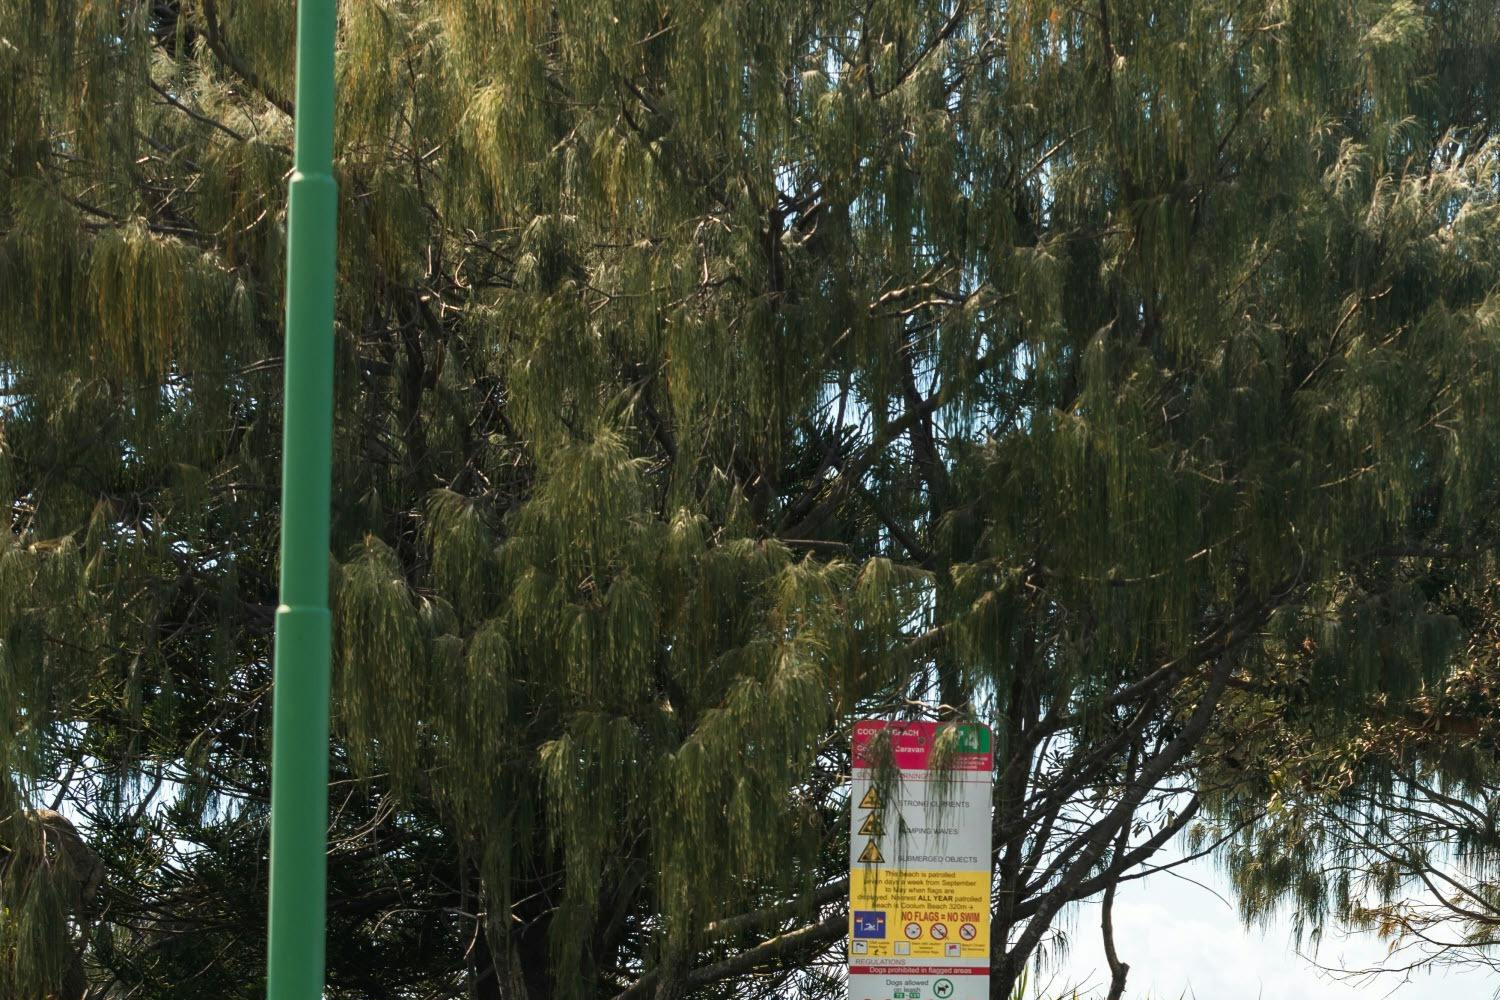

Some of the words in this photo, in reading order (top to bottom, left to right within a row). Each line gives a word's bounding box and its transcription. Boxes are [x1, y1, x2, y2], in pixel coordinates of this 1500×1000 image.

[857, 728, 890, 736] COOL
[897, 855, 943, 863] SUBMERGED
[944, 856, 978, 864] OBJECTS
[928, 871, 956, 880] patrolled
[942, 879, 976, 888] September
[927, 887, 943, 896] flags
[902, 911, 913, 921] NO
[914, 911, 939, 922] FLAGS
[947, 912, 958, 922] NO
[960, 912, 980, 923] SWIM
[855, 958, 906, 966] REGULATIONS
[869, 966, 886, 975] Dogs
[888, 966, 920, 976] prohibited
[929, 967, 952, 976] flagged
[886, 979, 903, 988] Dogs
